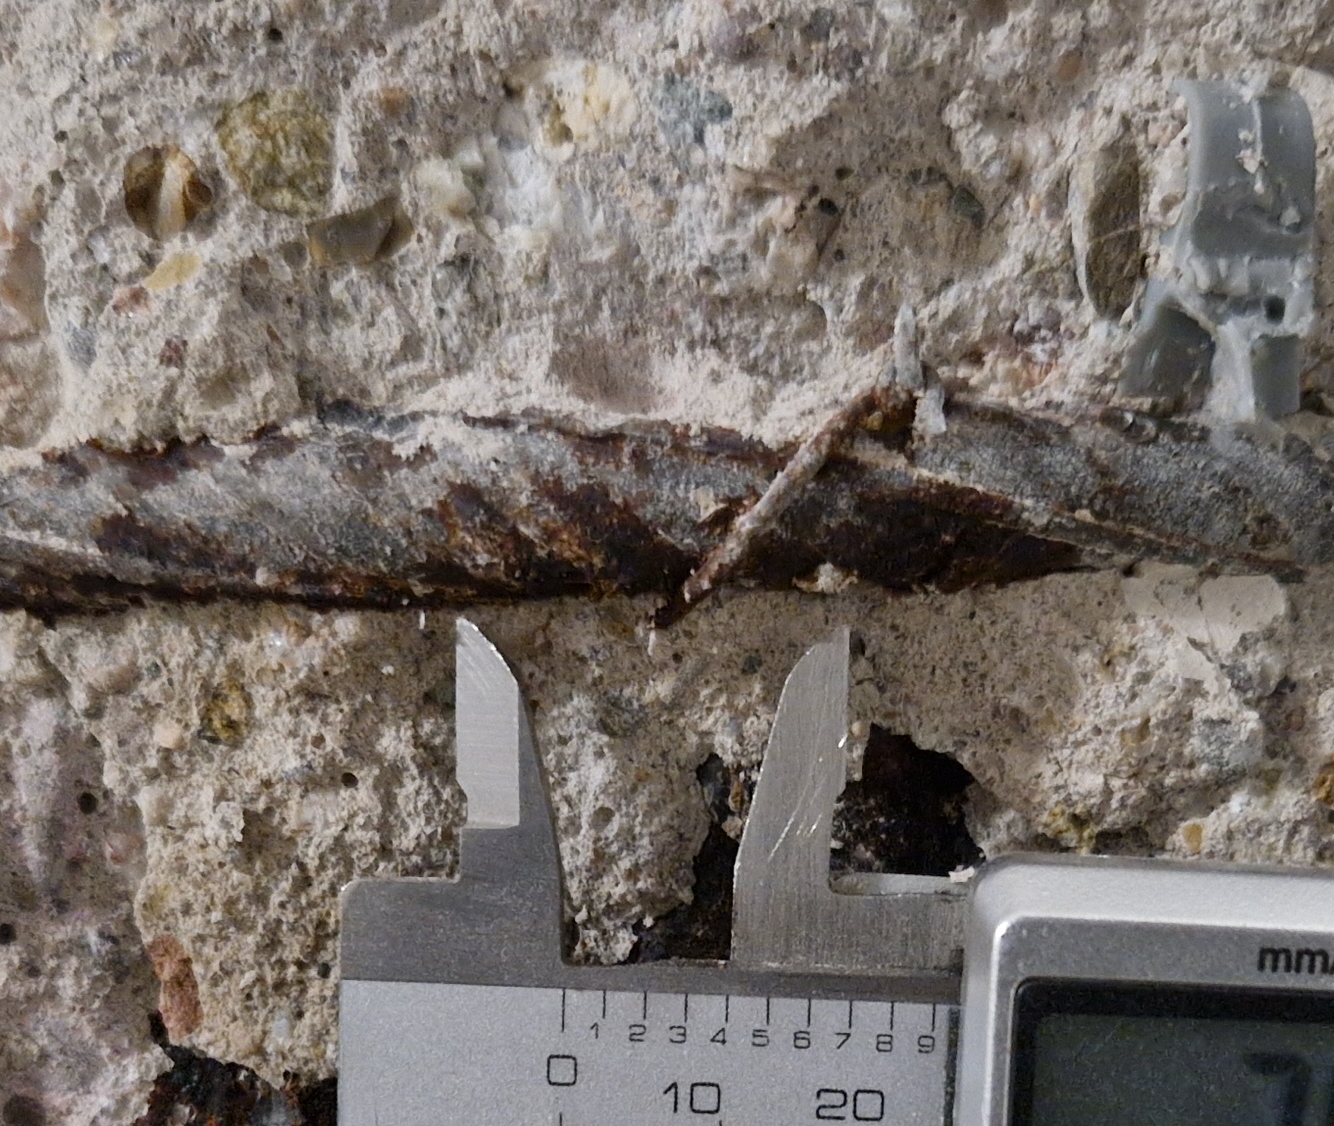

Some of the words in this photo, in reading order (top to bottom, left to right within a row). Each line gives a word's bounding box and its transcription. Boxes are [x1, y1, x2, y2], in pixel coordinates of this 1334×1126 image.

[589, 1021, 601, 1040] 1
[627, 1023, 648, 1043] 2
[668, 1024, 688, 1045] 3
[709, 1026, 728, 1046] 4
[750, 1028, 771, 1049] 5
[792, 1030, 812, 1051] 6
[834, 1031, 852, 1050] 7
[874, 1033, 895, 1054] 8
[916, 1035, 936, 1055] 9
[546, 1053, 579, 1087] 0
[662, 1080, 723, 1116] 10
[814, 1087, 886, 1122] 20
